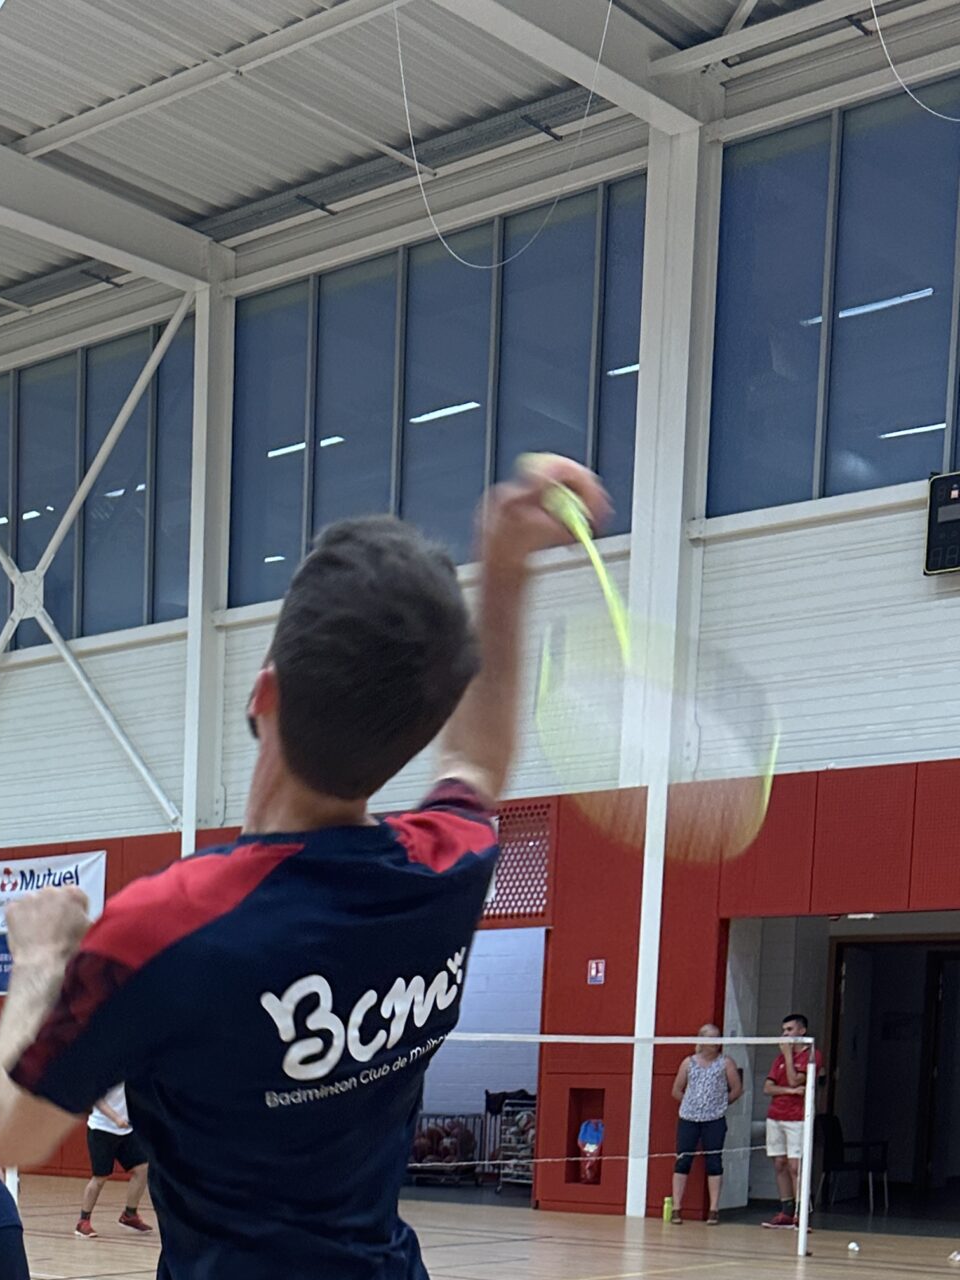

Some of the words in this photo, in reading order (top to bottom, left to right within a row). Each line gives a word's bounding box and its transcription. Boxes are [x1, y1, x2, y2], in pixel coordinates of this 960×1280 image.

[19, 865, 80, 891] Mutuel
[265, 1076, 357, 1107] Badminton
[359, 1065, 390, 1084] Club
[392, 1056, 408, 1071] de
